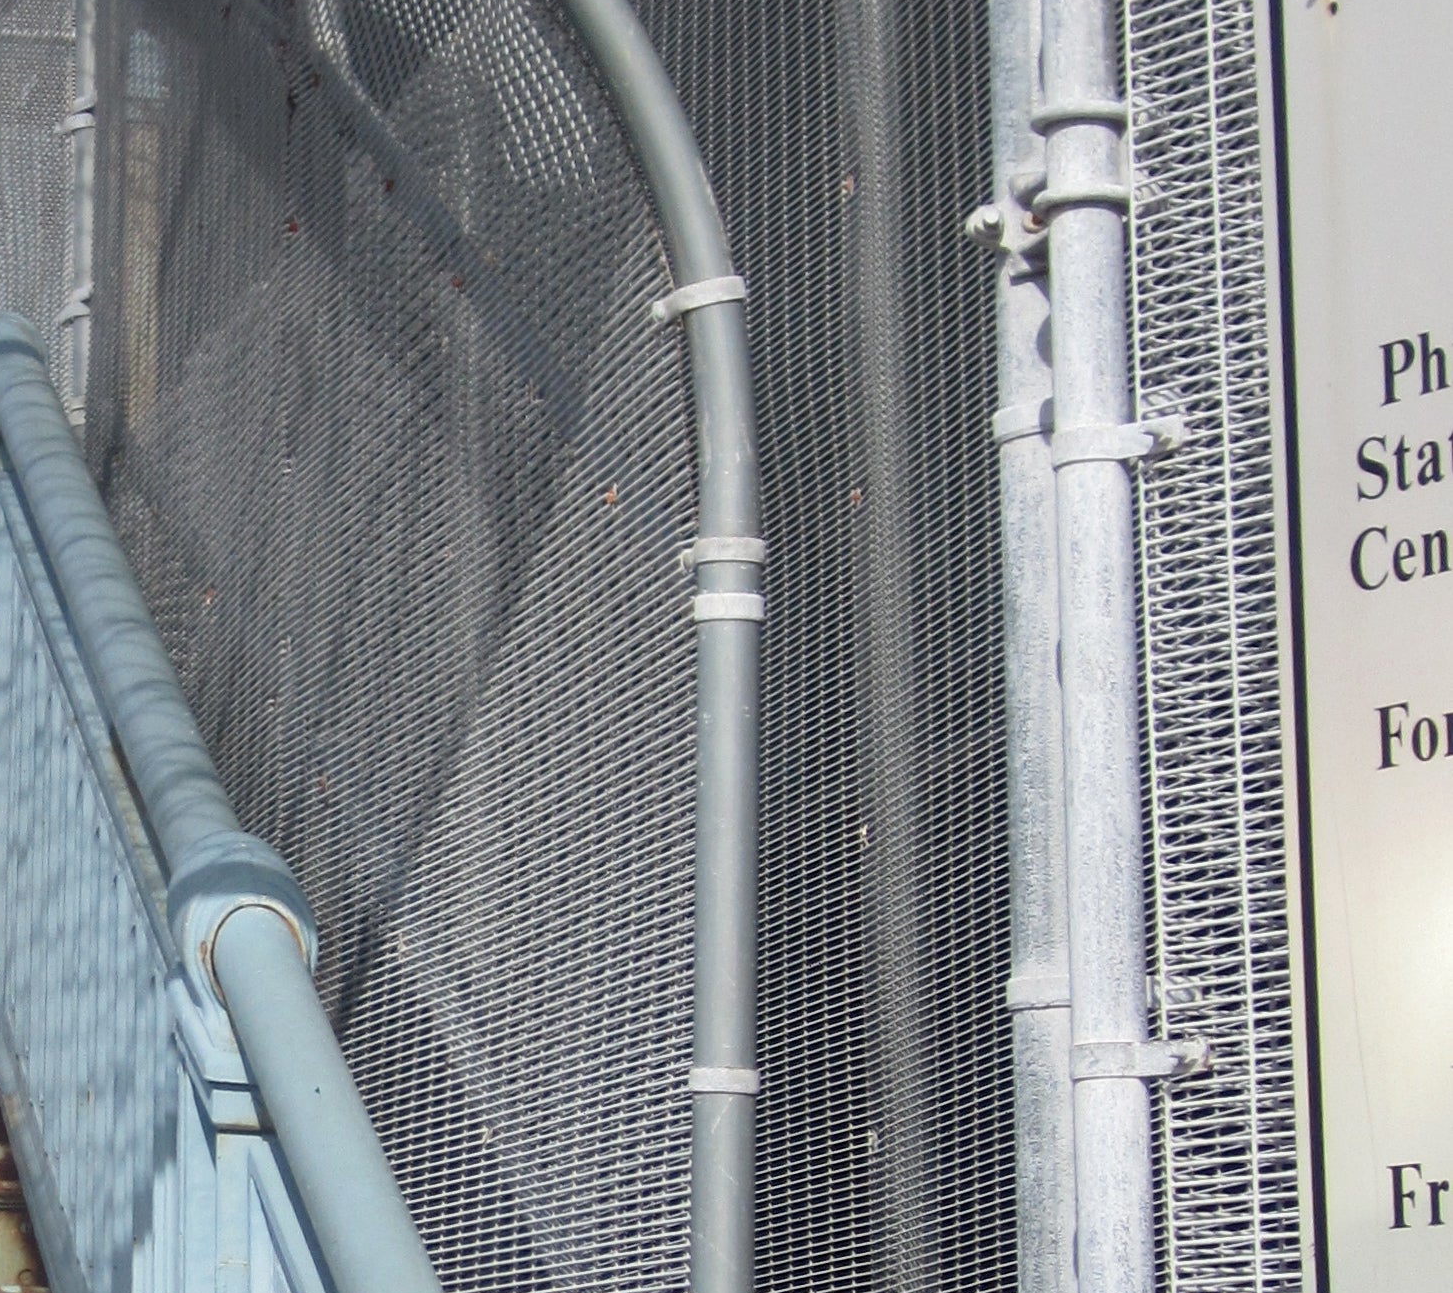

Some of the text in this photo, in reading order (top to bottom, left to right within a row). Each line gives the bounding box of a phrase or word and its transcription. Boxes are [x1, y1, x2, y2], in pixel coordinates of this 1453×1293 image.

[1357, 429, 1453, 502] Sta
[1350, 526, 1453, 591] Cen
[1386, 1163, 1450, 1229] Fr
